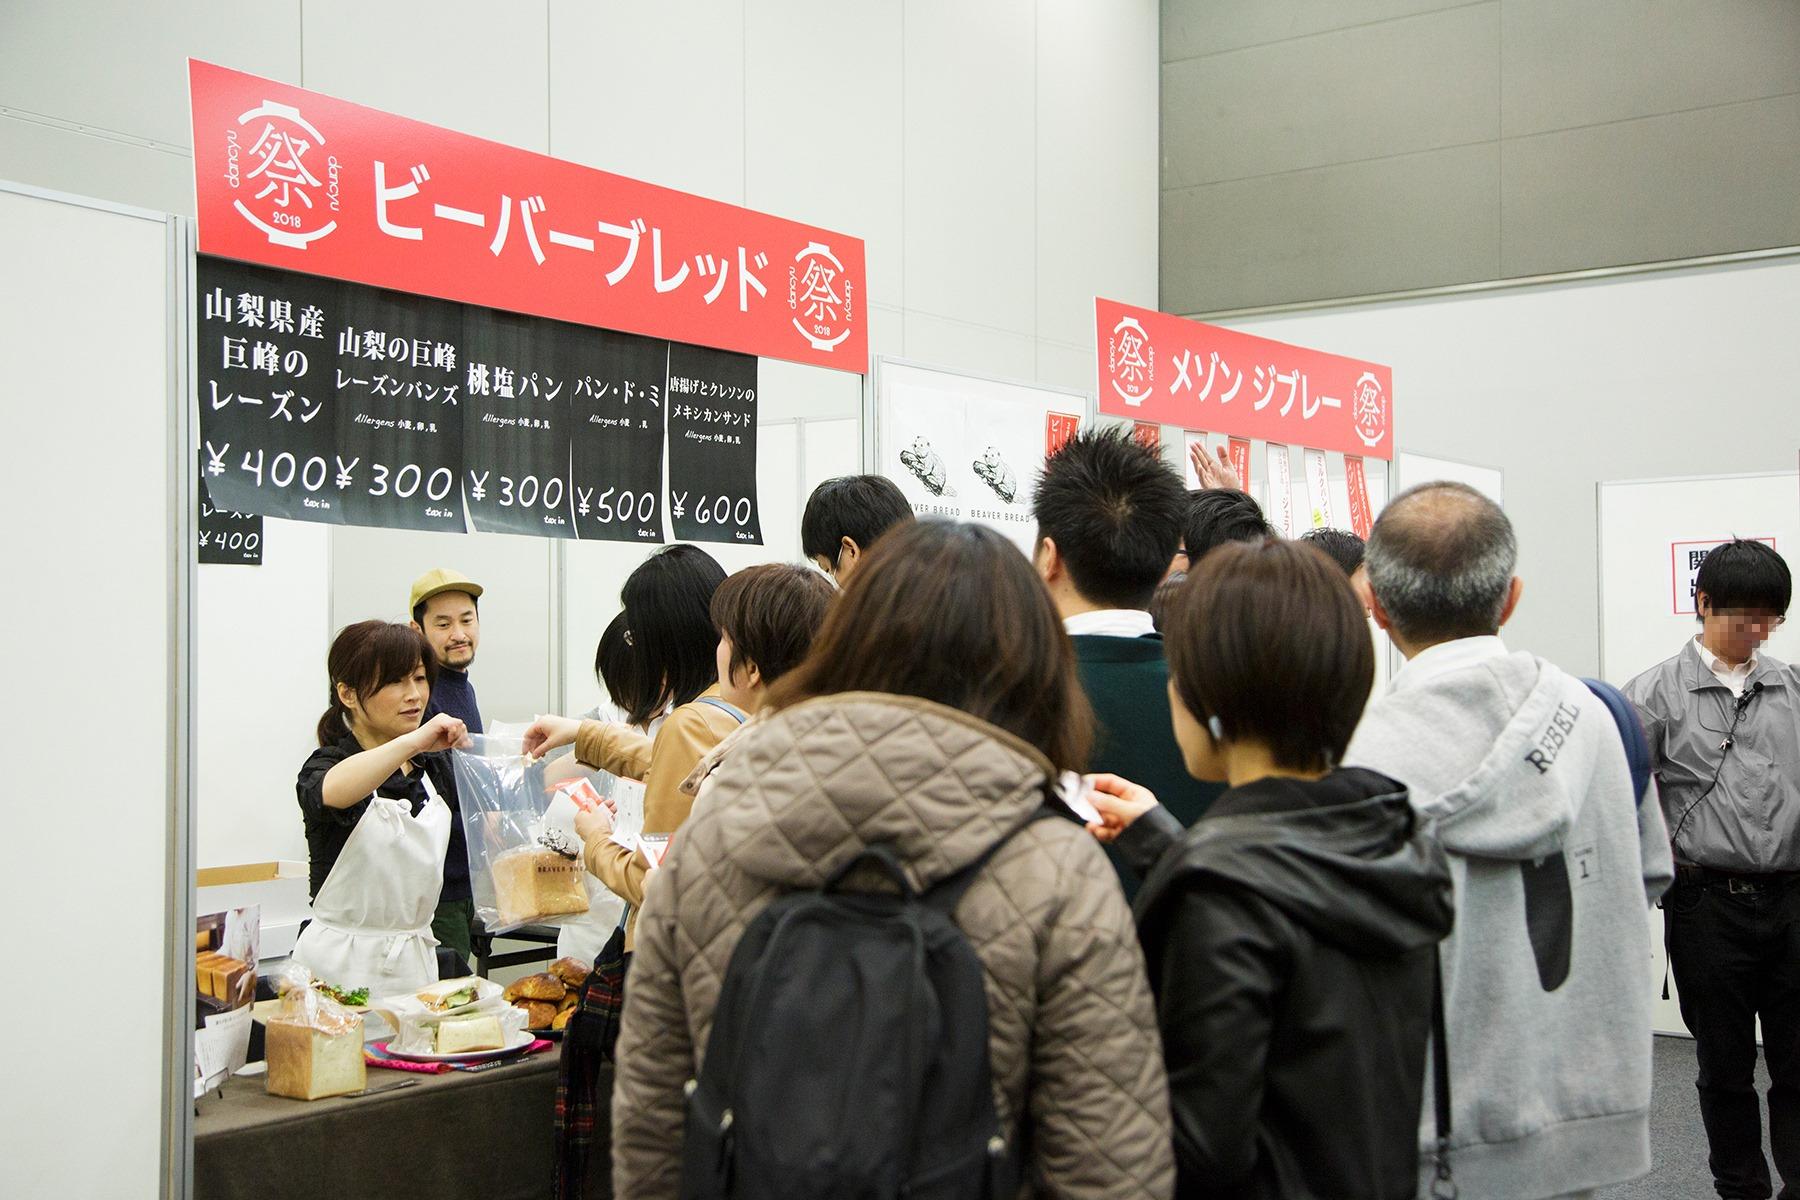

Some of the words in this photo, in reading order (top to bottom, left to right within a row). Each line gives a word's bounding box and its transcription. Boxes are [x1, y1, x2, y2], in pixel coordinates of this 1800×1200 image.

[223, 129, 242, 188] dancyu
[247, 122, 322, 209] 祭
[327, 155, 343, 211] dancyu
[272, 211, 302, 229] 2018
[374, 160, 769, 313] ビーバーブレッド
[800, 258, 843, 321] 祭
[205, 287, 325, 339] 山梨県産
[222, 335, 309, 378] 巨峰の
[338, 326, 456, 372] 山梨の巨峰
[1117, 330, 1148, 382] 祭
[209, 380, 323, 424] レーズン
[336, 368, 459, 406] レーズンバンズ
[466, 361, 564, 401] 桃塩パン
[669, 376, 756, 402] 唐揚げとクレソンの
[1169, 349, 1243, 404] メゾン
[1253, 364, 1341, 420] ジブレー
[354, 413, 396, 430] Allergens
[482, 413, 516, 428] Allergens
[589, 414, 618, 428] Allergens
[672, 404, 752, 428] メキシカンサンド
[1359, 383, 1381, 427] 祭
[933, 505, 960, 516] BREAD
[970, 509, 1001, 520] BEAVER
[1004, 513, 1030, 523] BREAD
[1524, 702, 1580, 774] REBEL
